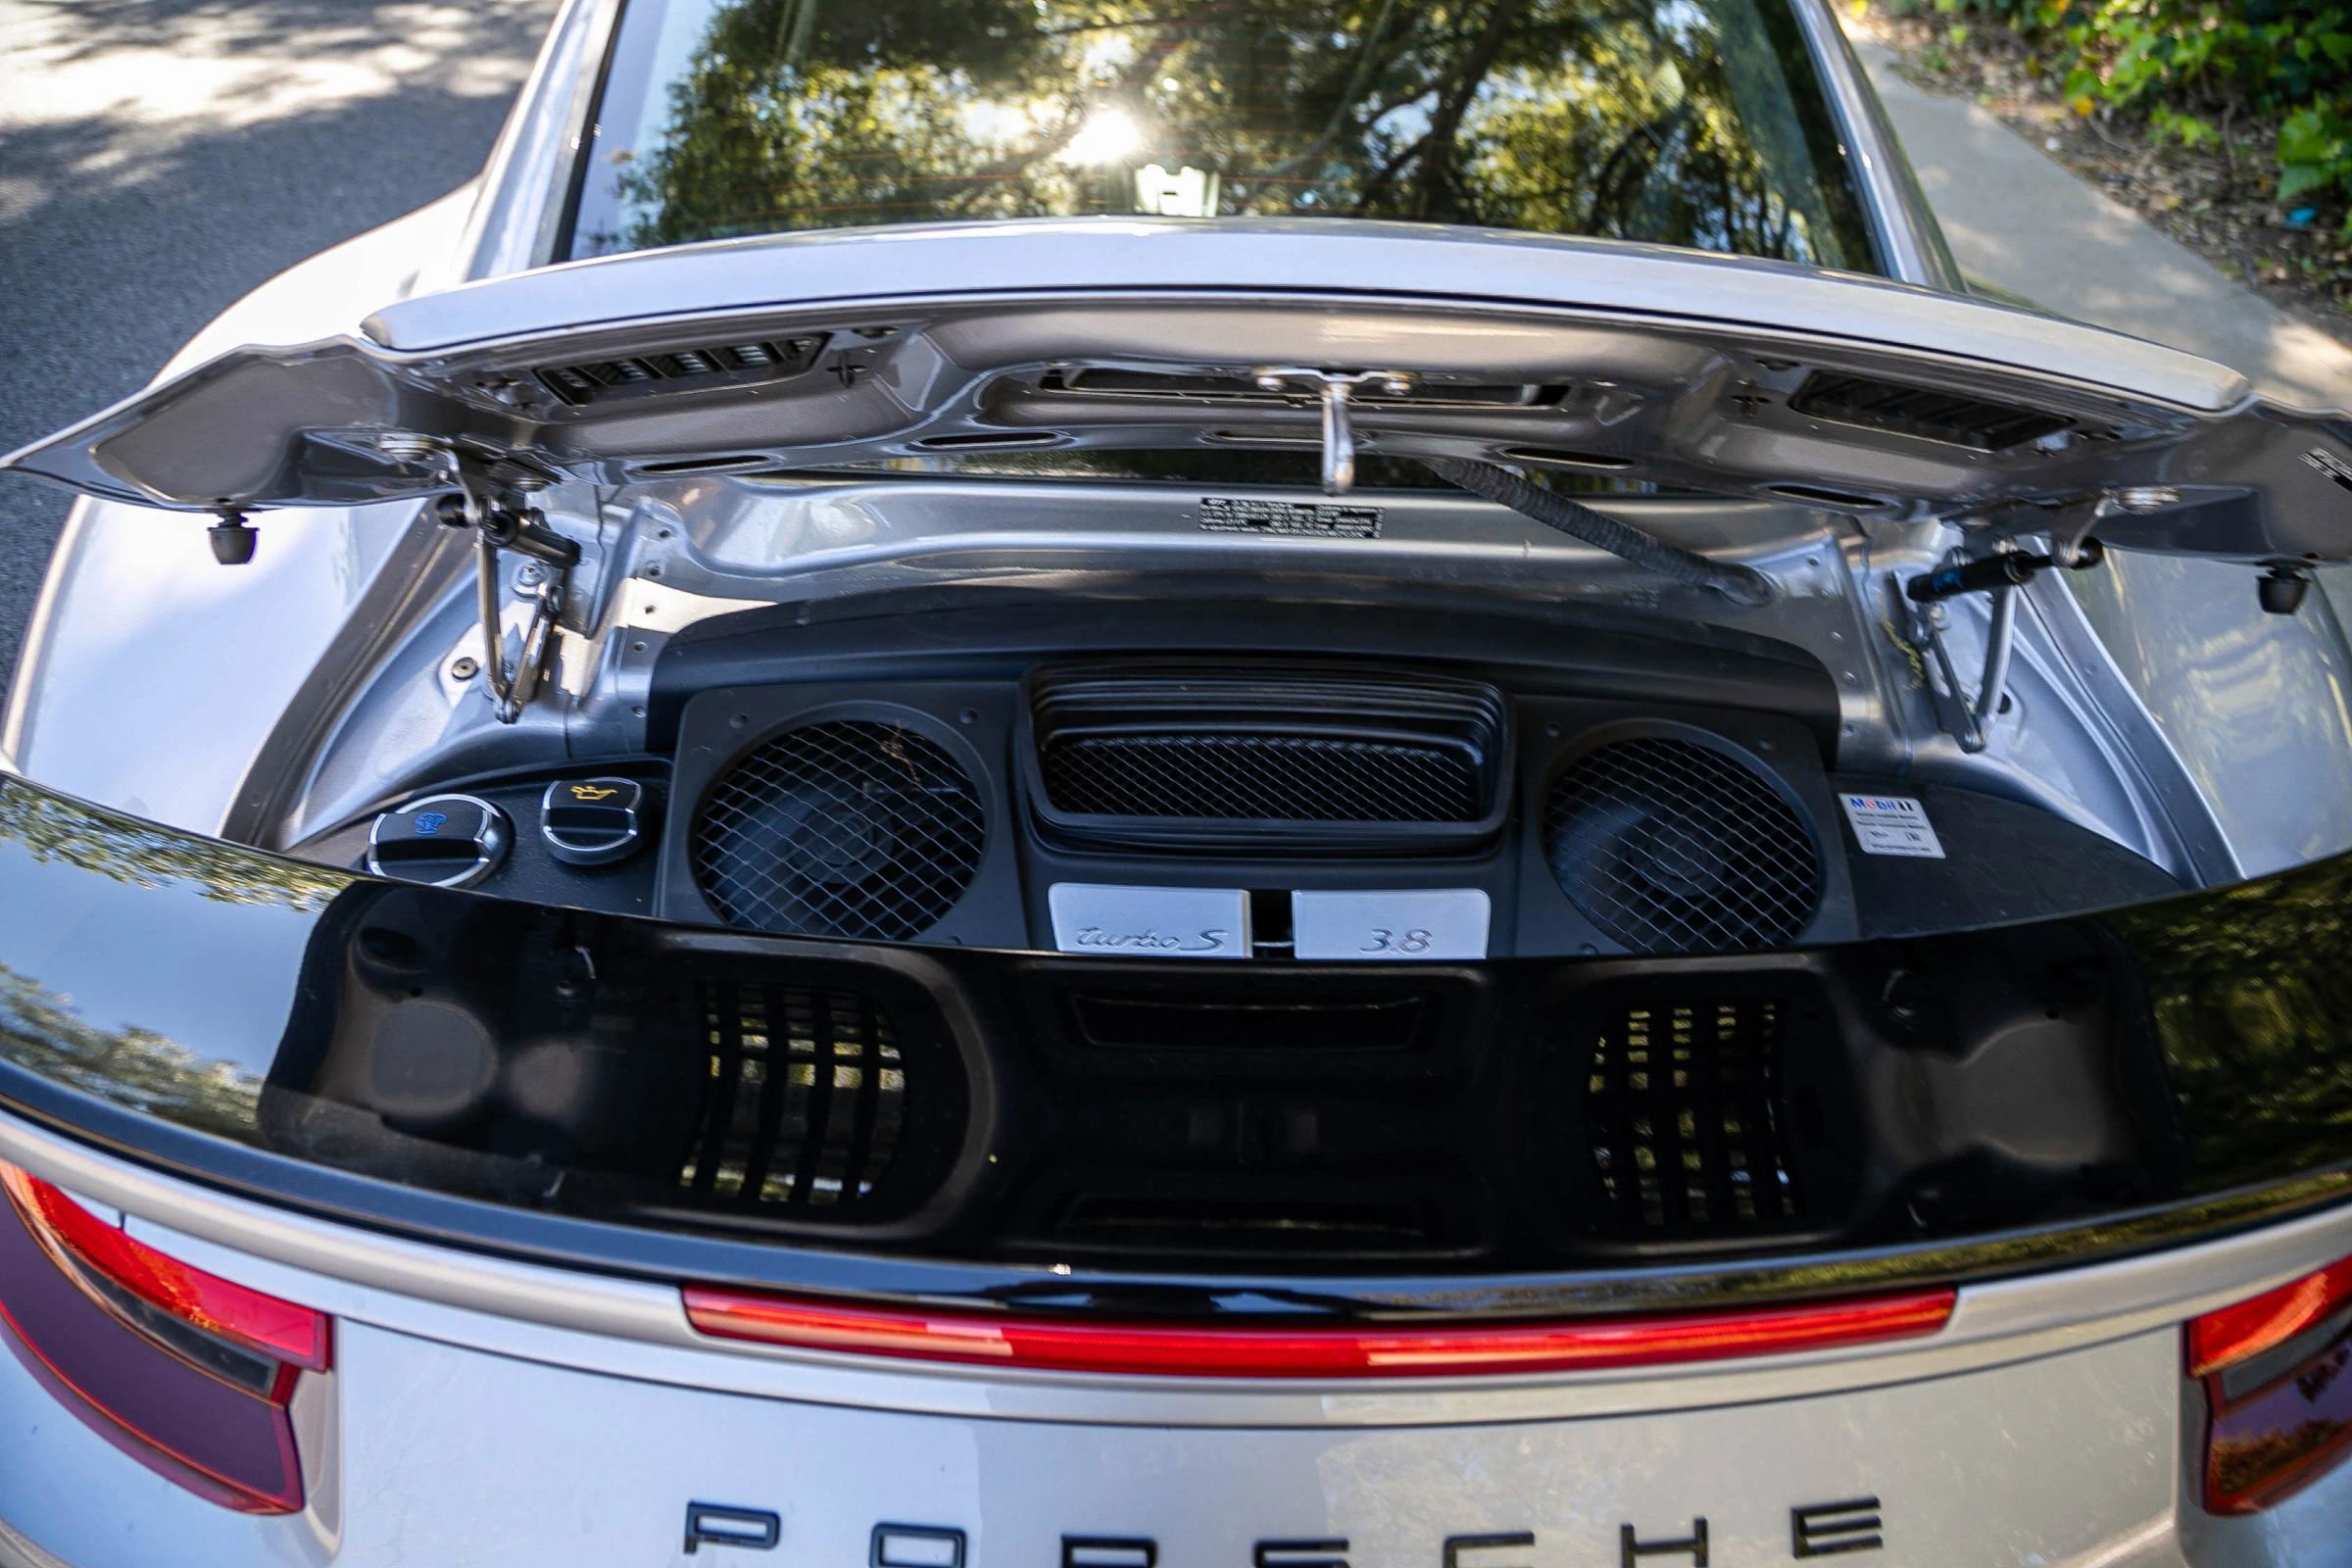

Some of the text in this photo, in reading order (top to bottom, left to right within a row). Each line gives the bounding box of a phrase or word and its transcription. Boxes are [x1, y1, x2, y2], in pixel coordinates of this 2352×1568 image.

[1848, 797, 1897, 811] Mobil
[1179, 930, 1228, 953] S
[1358, 928, 1433, 956] 3.8
